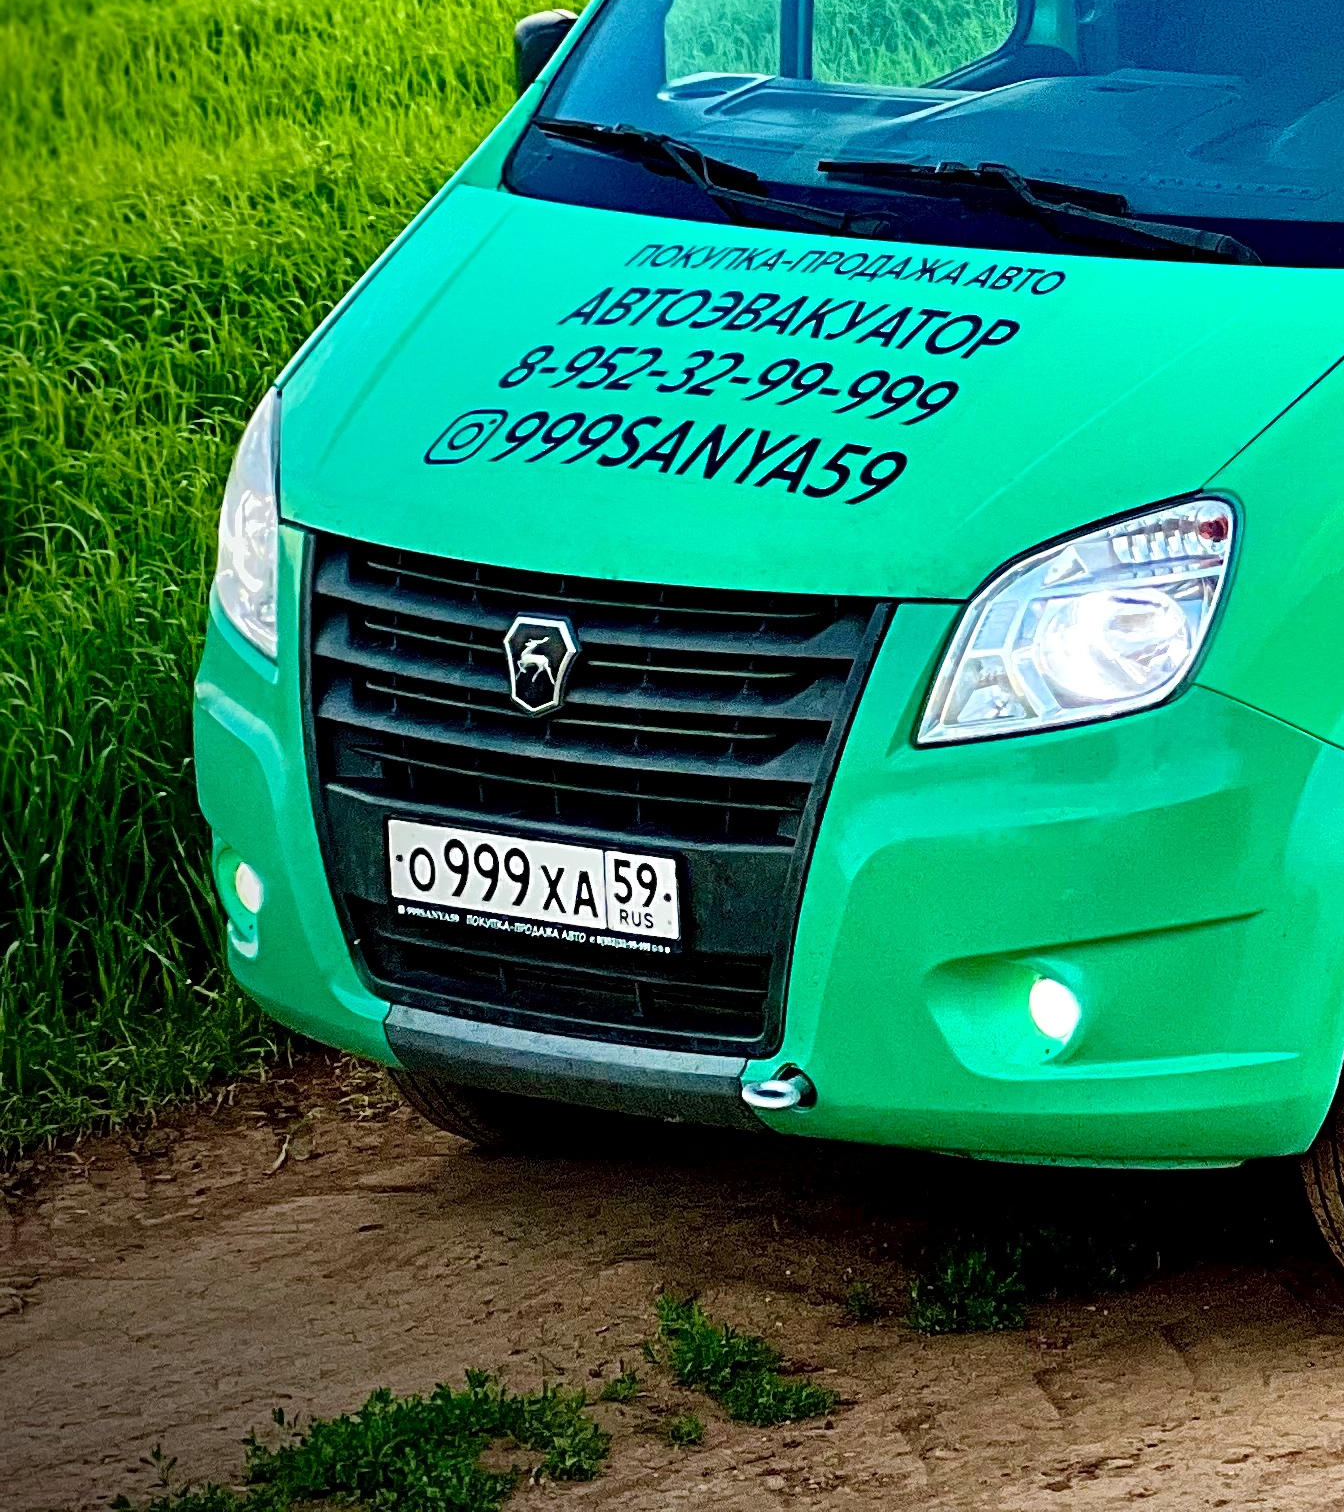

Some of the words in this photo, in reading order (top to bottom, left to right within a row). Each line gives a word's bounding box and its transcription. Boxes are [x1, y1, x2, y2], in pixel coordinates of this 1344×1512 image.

[624, 243, 966, 287] ПОКУПКА-ПРОДАЖА
[965, 263, 1066, 296] АВТО
[557, 286, 1021, 360] АВТОЭВАКУАТОР
[498, 345, 960, 426] 8-952-32-99-999
[487, 409, 909, 506] 999SANYA59
[613, 858, 658, 908] 59
[618, 911, 655, 930] RUS
